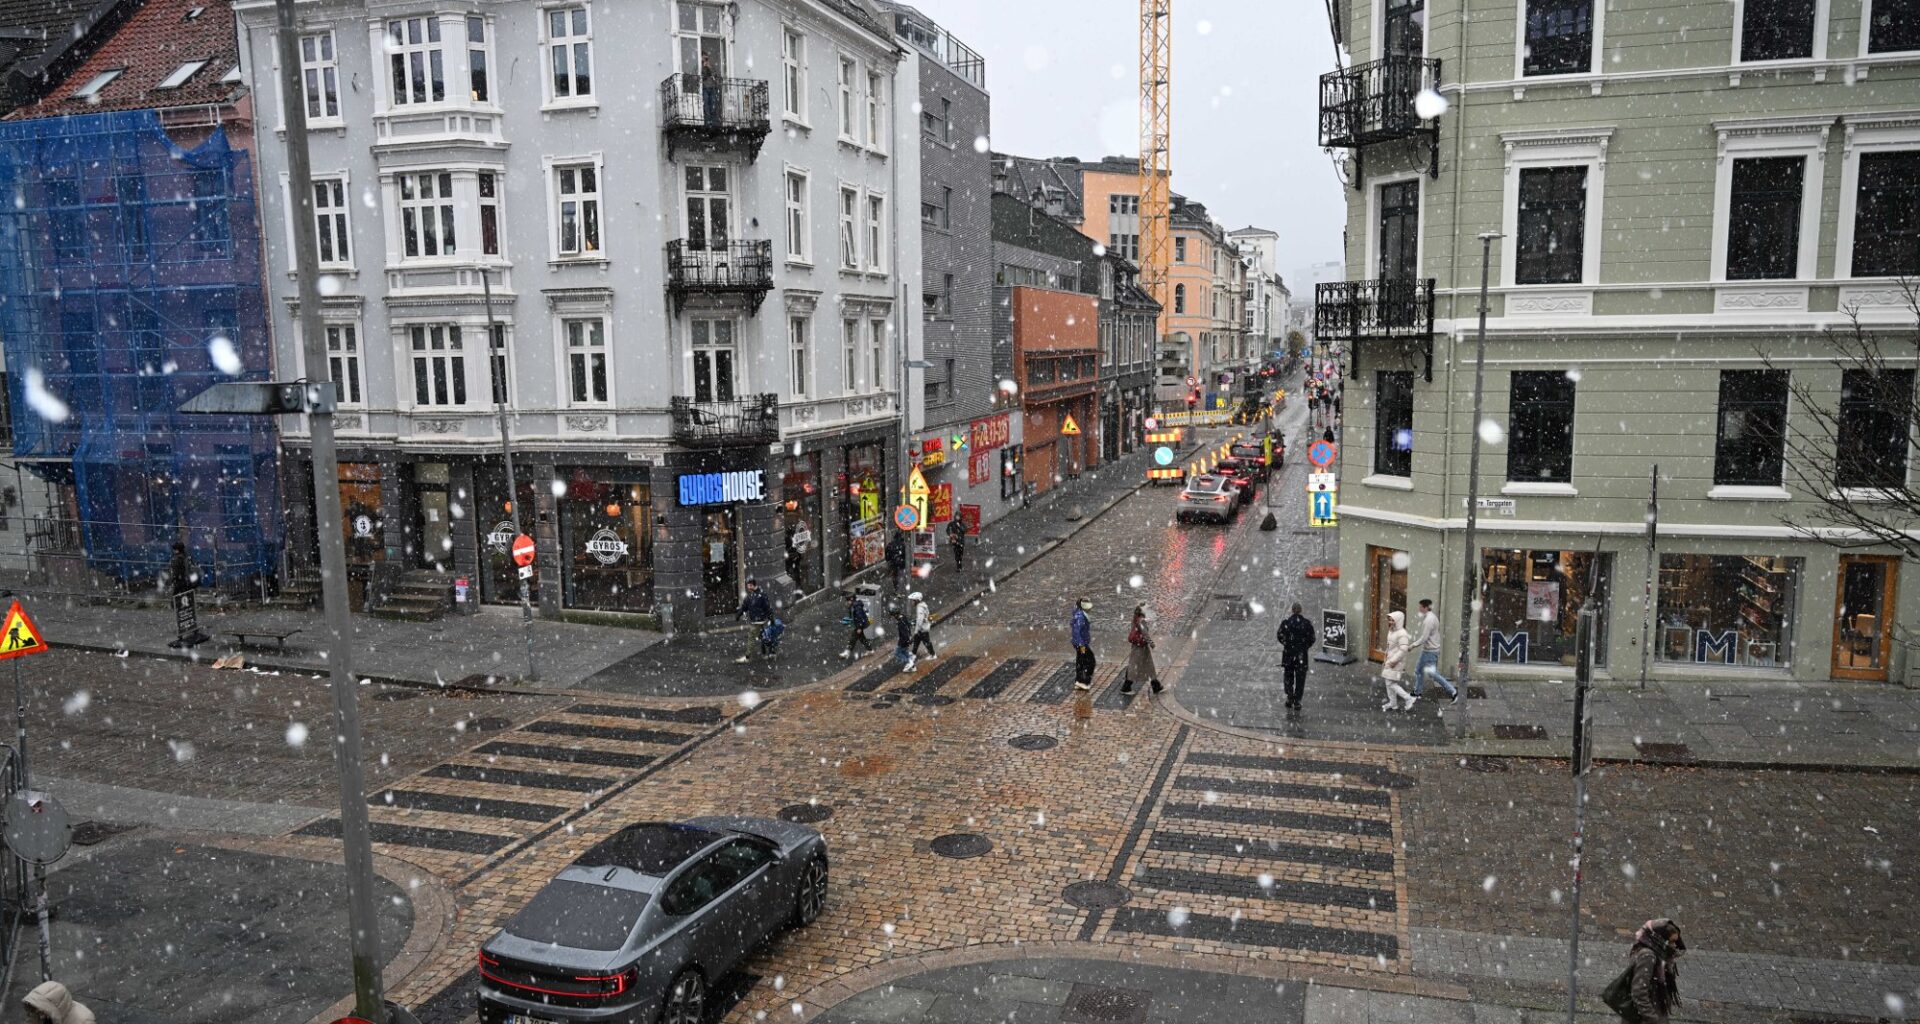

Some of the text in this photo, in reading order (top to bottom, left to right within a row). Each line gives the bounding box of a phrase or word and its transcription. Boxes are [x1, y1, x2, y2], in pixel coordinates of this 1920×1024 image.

[1486, 500, 1513, 508] Torggaten
[592, 541, 621, 551] GYROS
[1490, 630, 1529, 663] M
[1695, 629, 1738, 664] M
